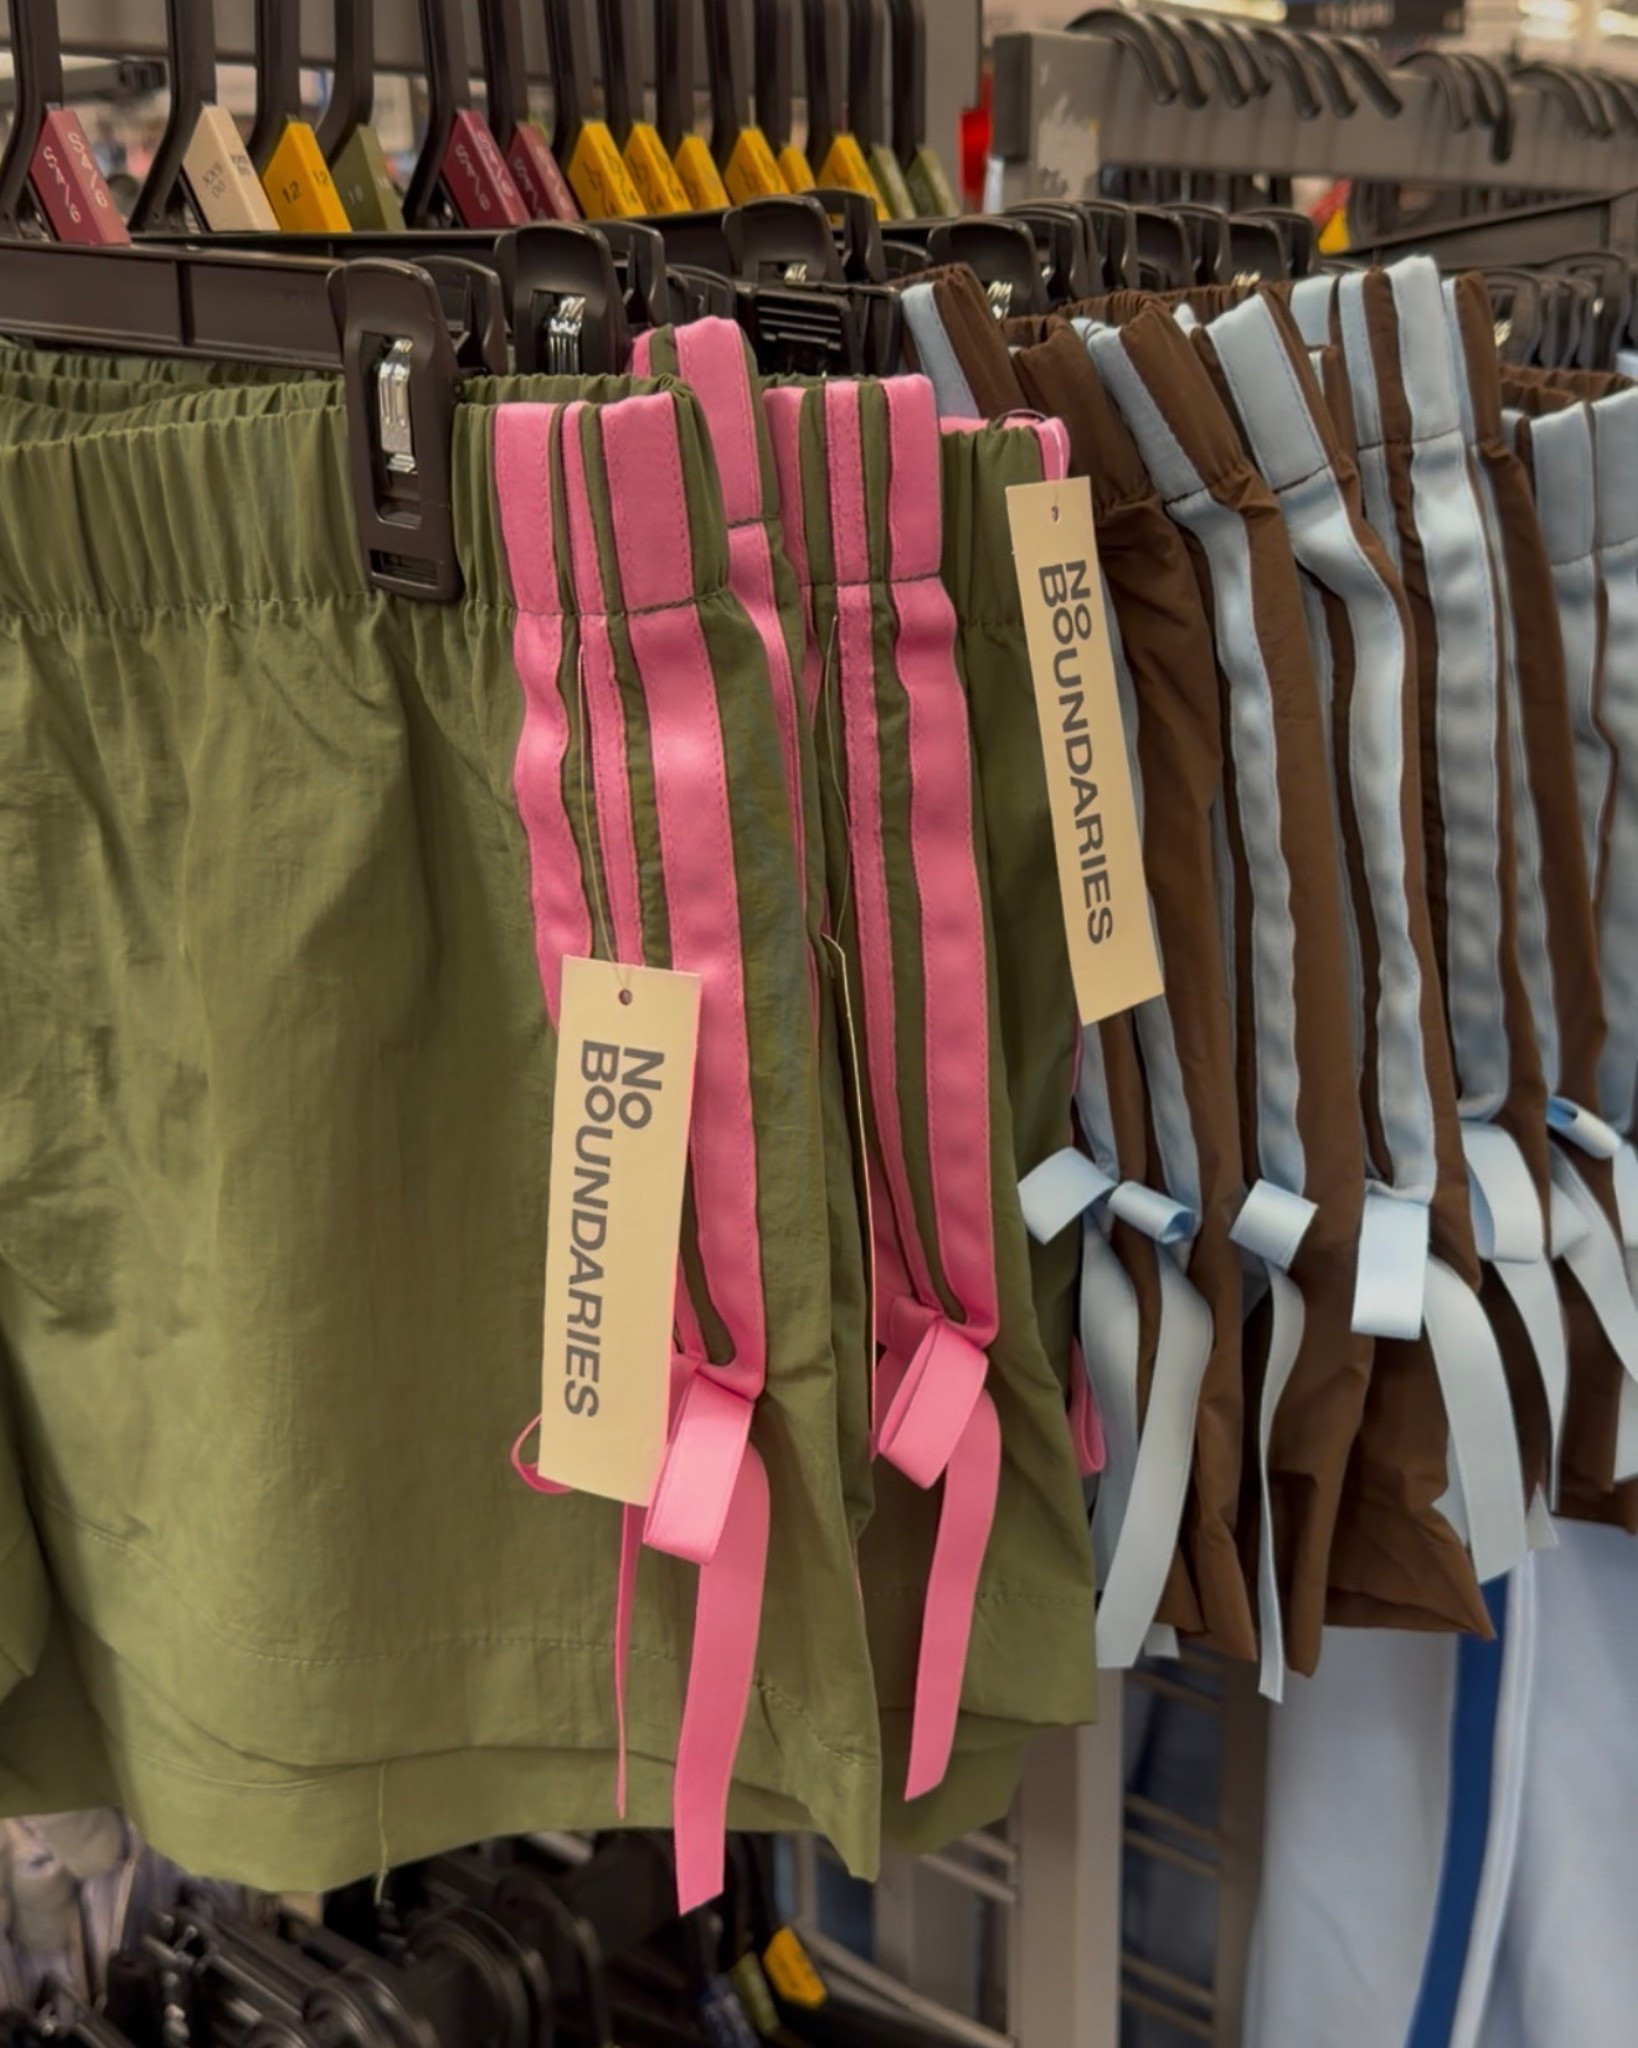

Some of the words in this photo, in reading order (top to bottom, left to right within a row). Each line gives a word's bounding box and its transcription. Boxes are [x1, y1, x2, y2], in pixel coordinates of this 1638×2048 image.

[1065, 559, 1092, 641] NO
[1038, 564, 1113, 945] BOUNDARIES
[618, 1047, 665, 1130] NO
[564, 1039, 620, 1418] BOUNDARIES
